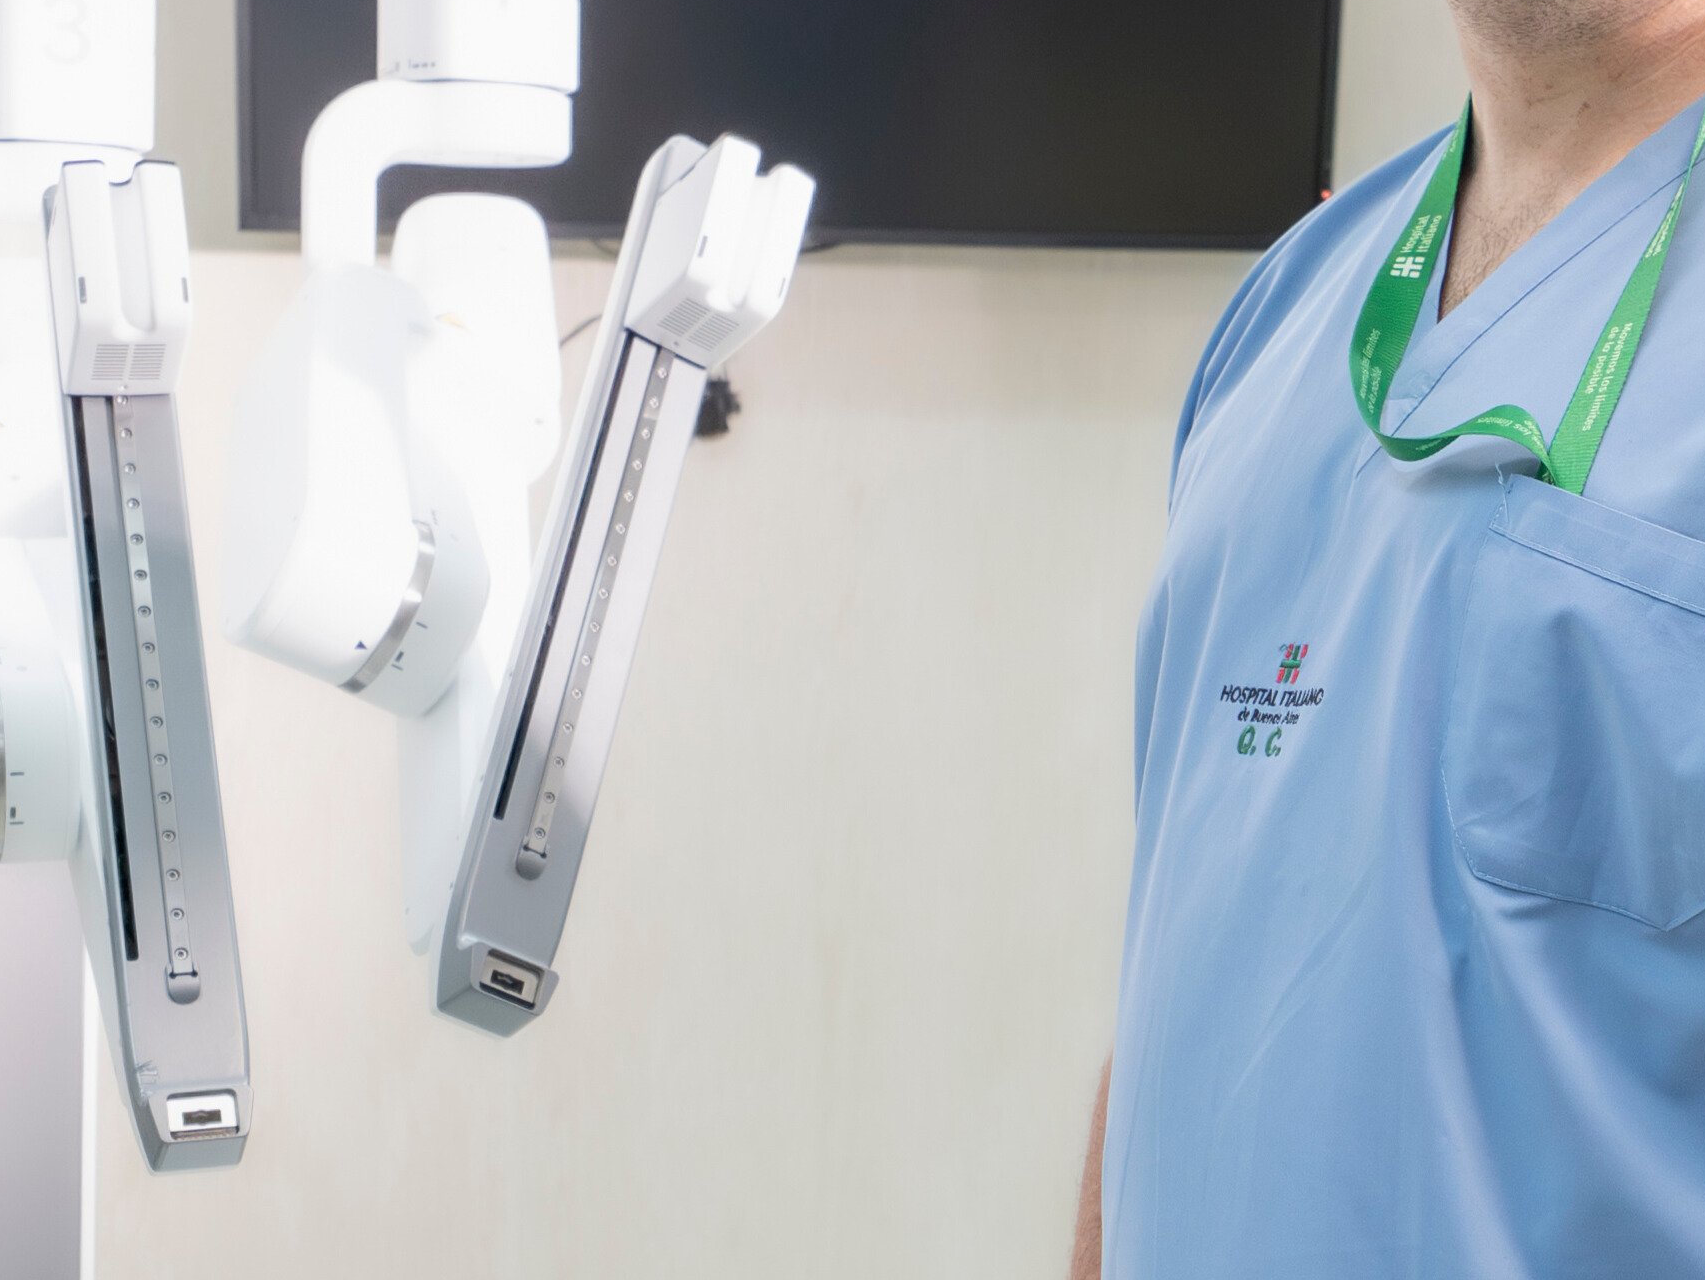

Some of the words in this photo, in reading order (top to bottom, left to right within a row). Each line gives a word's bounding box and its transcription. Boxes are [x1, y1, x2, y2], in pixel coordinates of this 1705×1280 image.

[1400, 215, 1431, 254] Hospital
[1420, 215, 1443, 253] Italiano
[1608, 326, 1619, 339] de
[1606, 322, 1633, 374] Movemos
[1585, 355, 1607, 394] posible
[1599, 375, 1613, 393] los
[1220, 684, 1278, 707] HOSPITAL
[1279, 687, 1325, 707] ITALIANO
[1250, 708, 1282, 724] Buenos
